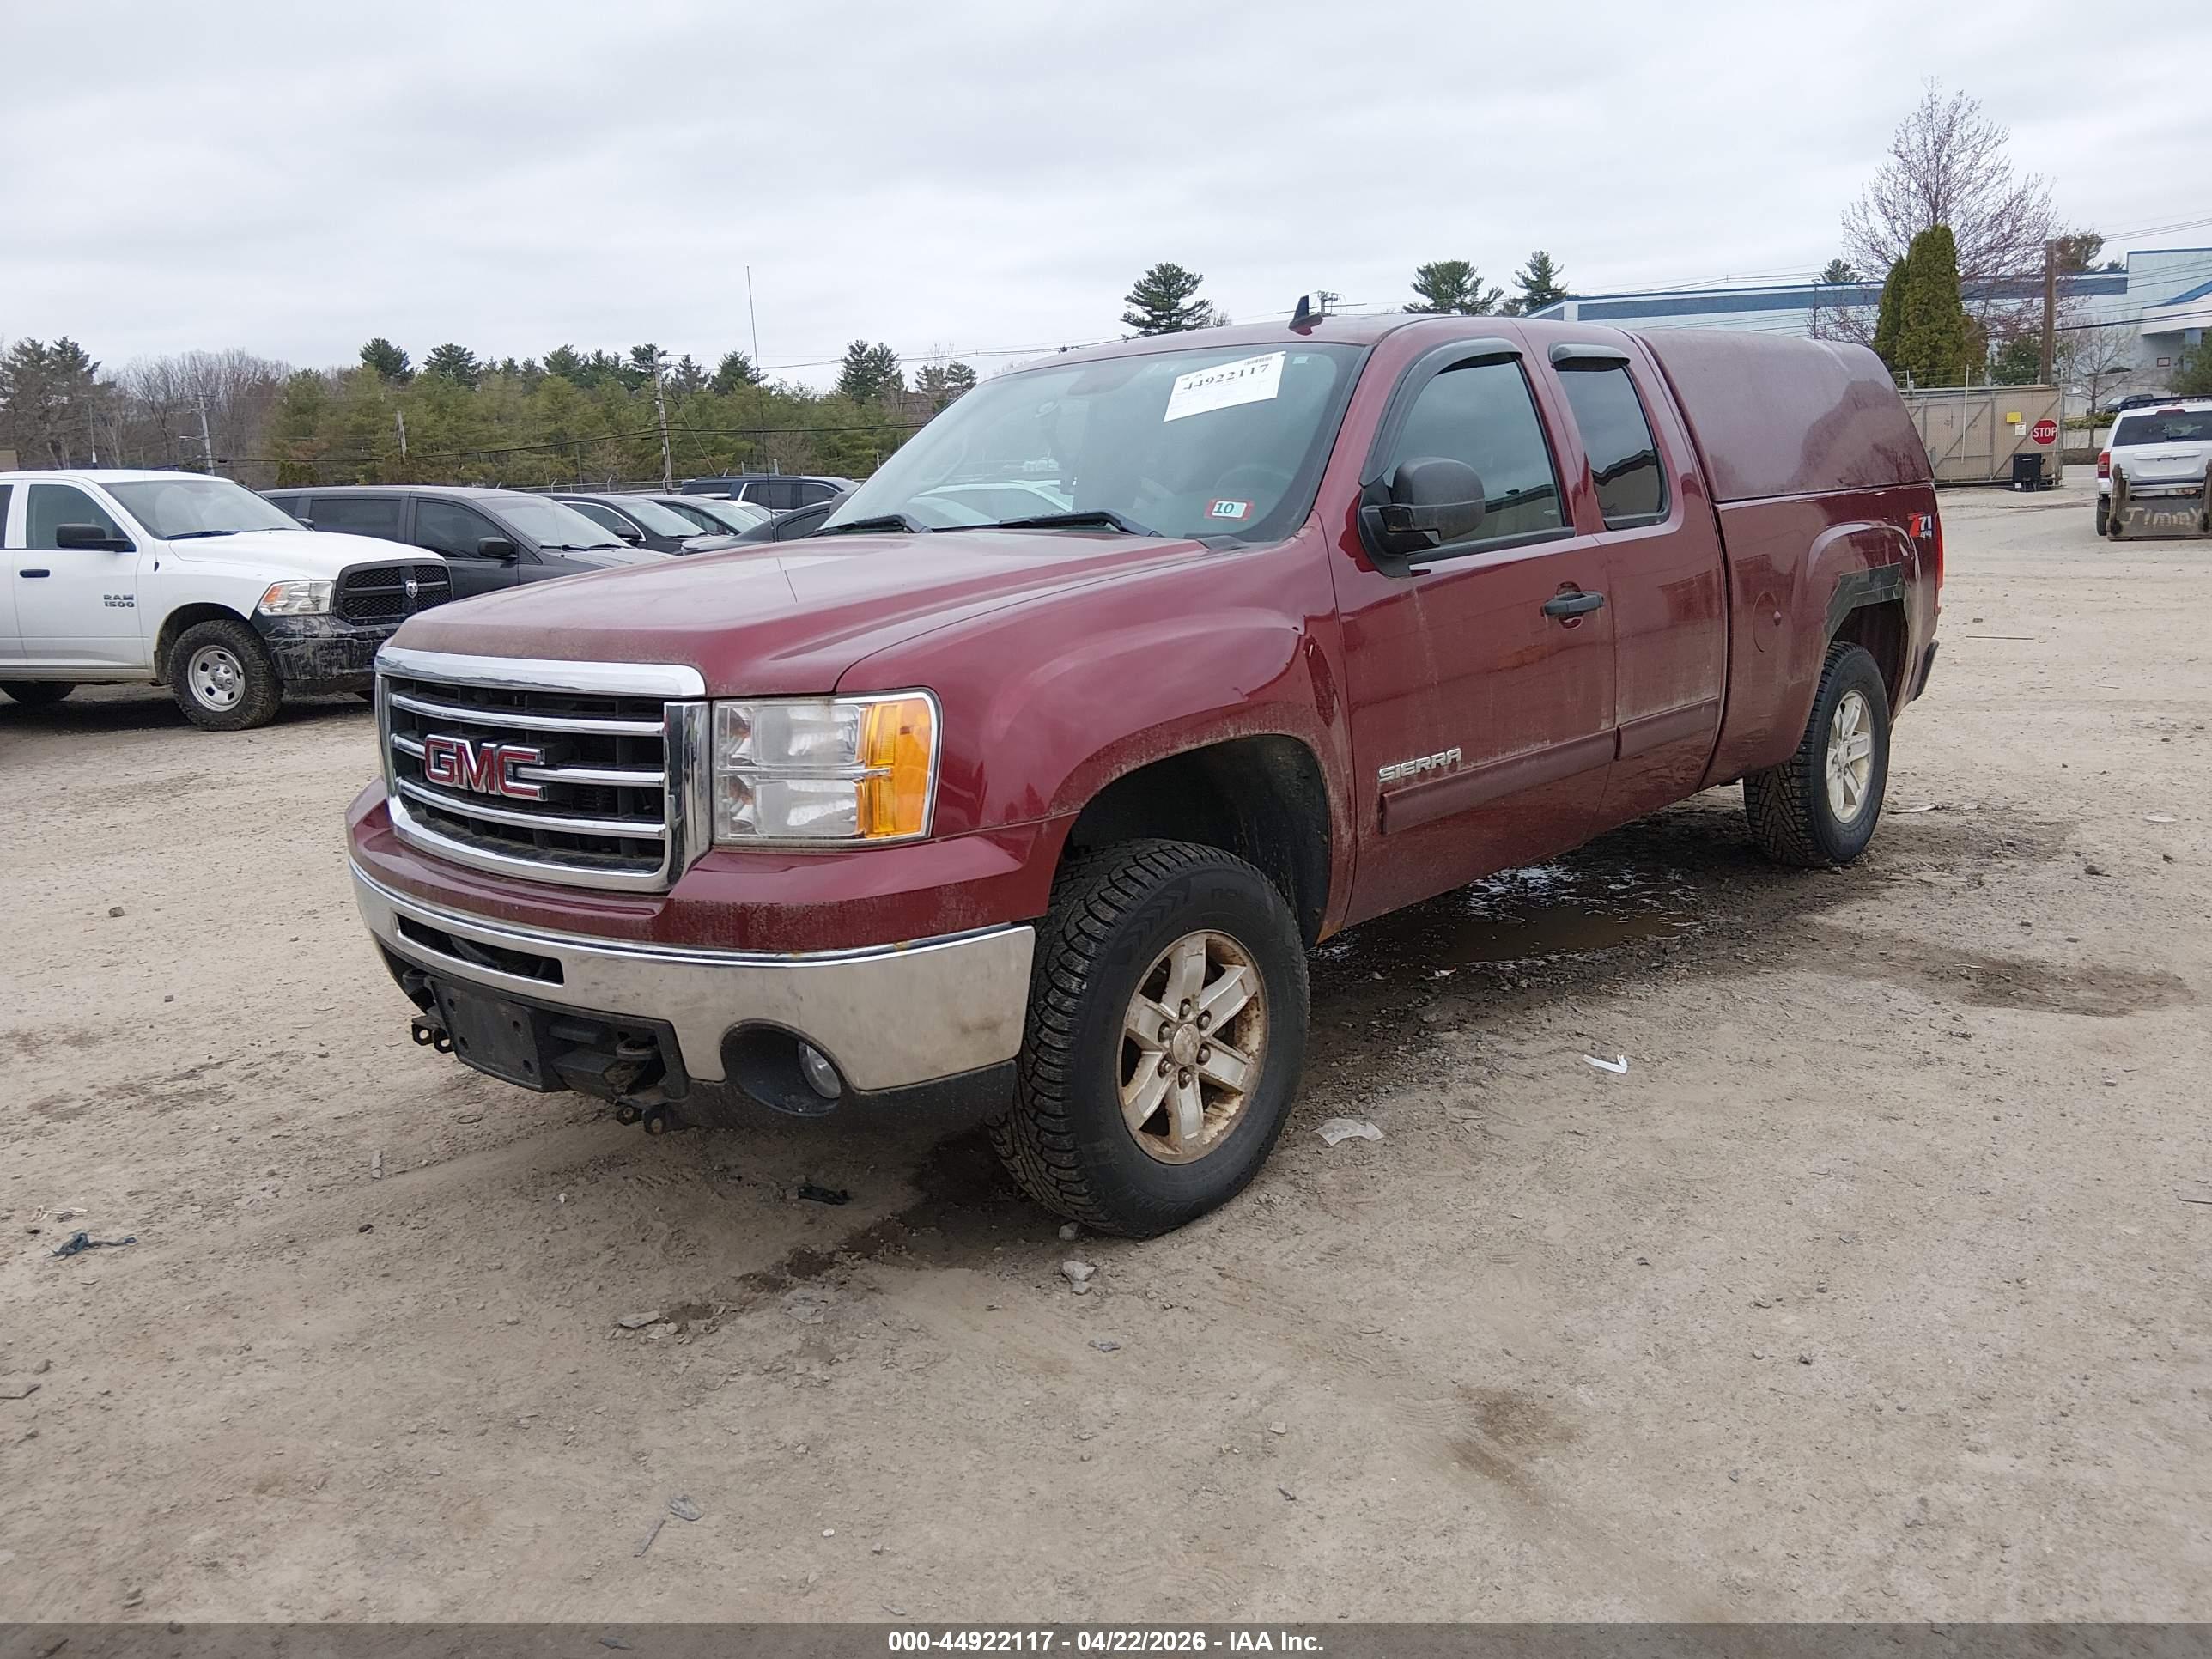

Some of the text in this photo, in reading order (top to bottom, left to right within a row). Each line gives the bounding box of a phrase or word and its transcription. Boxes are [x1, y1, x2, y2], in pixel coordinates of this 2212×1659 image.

[1183, 363, 1269, 391] 44922117
[2033, 427, 2057, 438] STOP
[1213, 502, 1235, 514] 10
[425, 734, 548, 802] GMC
[1379, 748, 1462, 783] SIERRA
